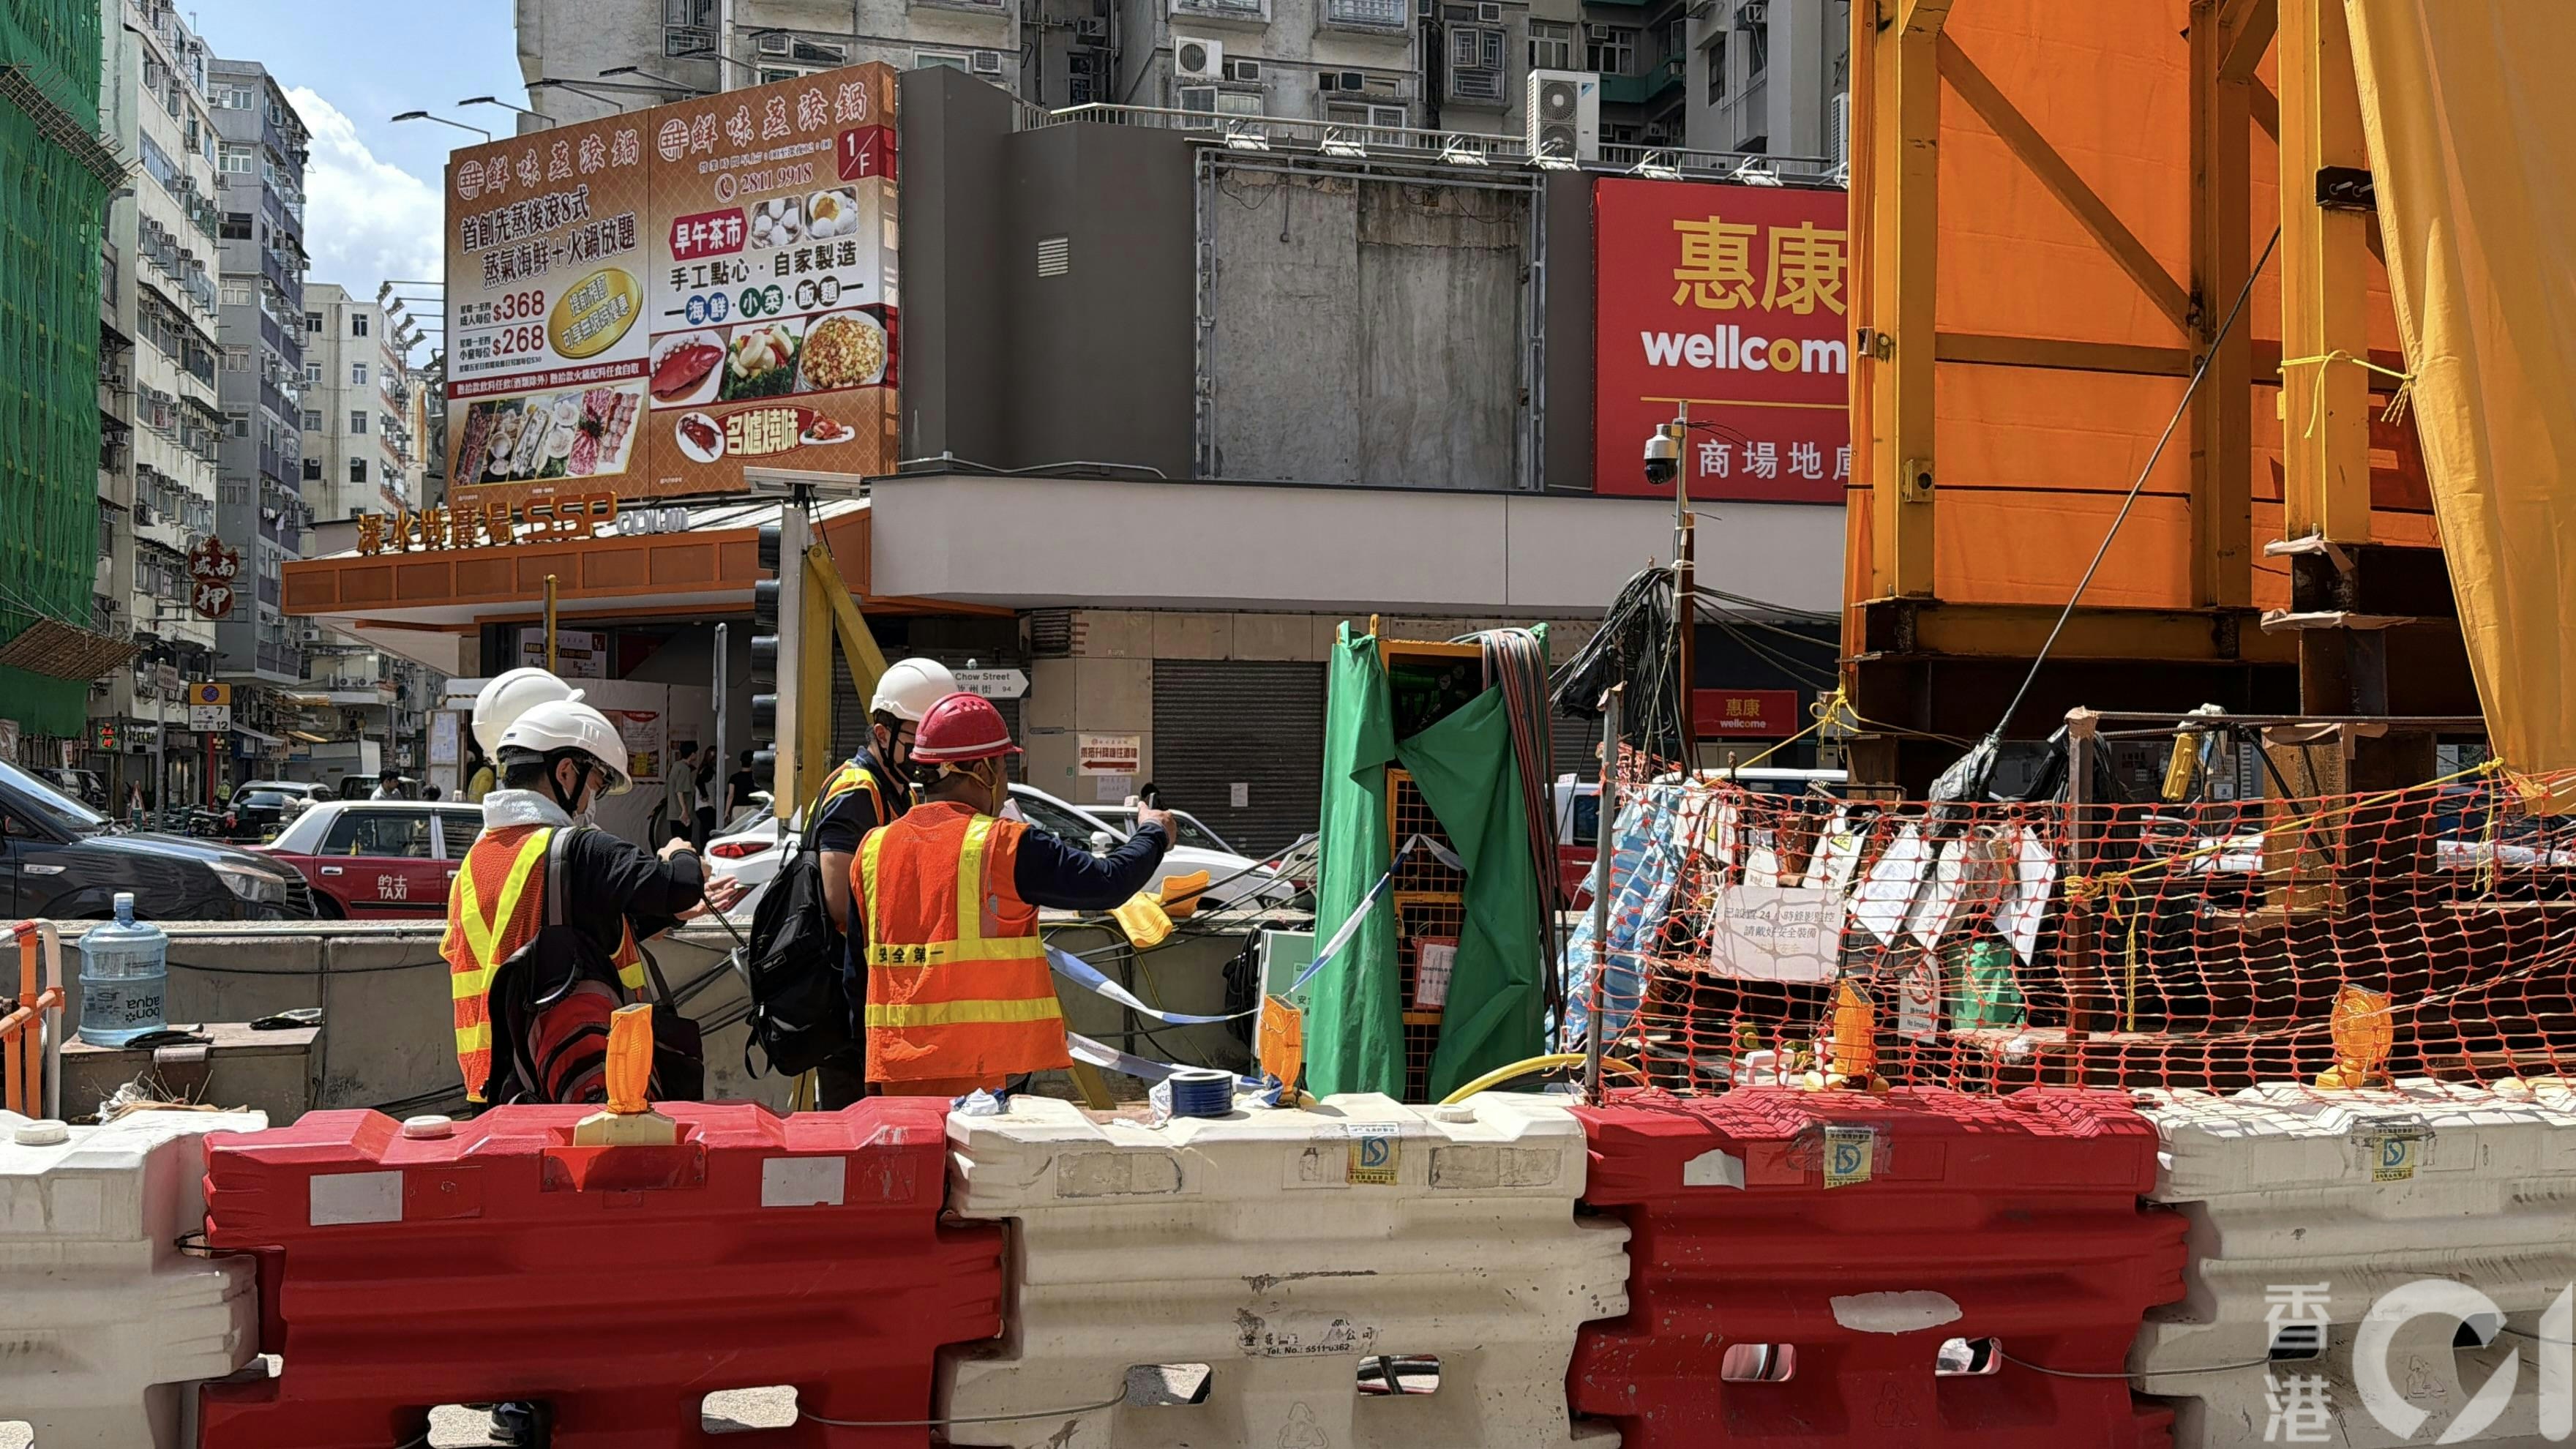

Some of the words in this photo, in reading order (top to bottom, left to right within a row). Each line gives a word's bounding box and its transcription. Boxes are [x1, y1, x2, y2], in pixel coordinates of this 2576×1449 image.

[847, 130, 877, 177] 1/F
[740, 169, 774, 194] 2811
[777, 162, 813, 188] 9918
[462, 184, 590, 254] 首創先蒸後滾8式
[675, 216, 742, 255] 早午茶市
[1672, 216, 1847, 315] 惠康
[493, 290, 544, 322] $368
[493, 325, 544, 356] $268
[1641, 324, 1846, 374] wellcom
[459, 347, 491, 361] 小童每位
[726, 407, 798, 455] 名爐燒味
[196, 585, 229, 615] 押
[216, 706, 223, 716] 7
[1726, 697, 1760, 716] 惠康
[217, 721, 228, 730] 12
[1720, 719, 1766, 728] wellcome
[378, 874, 408, 886] 的士
[378, 886, 407, 899] TAXI
[1760, 910, 1770, 919] 24
[879, 946, 944, 963] 安全第一
[125, 995, 160, 1009] aqua
[136, 1007, 160, 1019] bon
